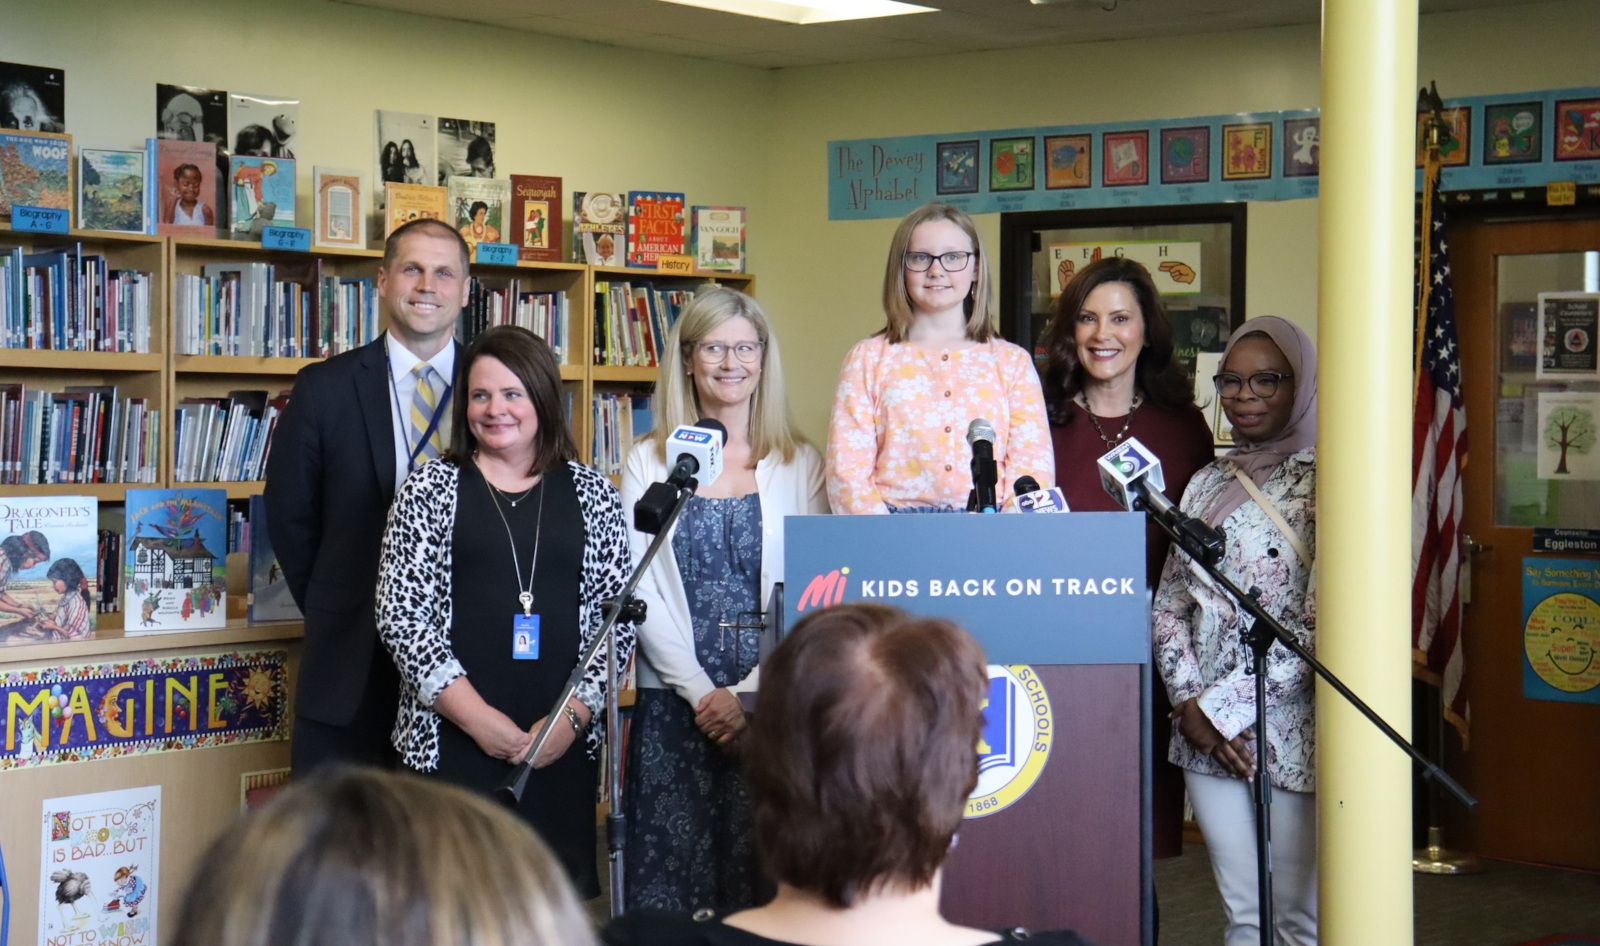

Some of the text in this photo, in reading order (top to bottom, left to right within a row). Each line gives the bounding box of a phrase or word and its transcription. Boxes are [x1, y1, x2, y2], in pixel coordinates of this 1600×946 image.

[32, 145, 68, 160] WOOF
[835, 145, 925, 179] The Dewey
[516, 185, 556, 200] Sequoyah
[846, 177, 919, 211] Alphabet
[20, 208, 62, 222] Biography
[641, 203, 679, 220] FIRST
[578, 223, 625, 236] ATHLETES
[640, 219, 678, 235] FACTS
[700, 225, 739, 234] VAN GOGH
[269, 229, 304, 241] Biography
[637, 244, 679, 254] AMERICAN
[1055, 248, 1062, 260] E
[1083, 248, 1089, 259] F
[1114, 247, 1125, 259] G
[1158, 245, 1168, 257] H
[661, 260, 690, 272] History
[1105, 443, 1131, 461] WNEM
[1118, 448, 1141, 478] 5
[1021, 499, 1034, 507] abc
[1032, 490, 1055, 509] 12
[0, 504, 90, 519] DRAGONFLY'S
[1035, 504, 1058, 513] NEWS
[5, 518, 42, 533] TALE
[1544, 538, 1597, 551] Eggleston
[1526, 566, 1542, 578] Say
[1545, 566, 1592, 581] Something
[862, 578, 1135, 597] KIDS BACK ON TRACK
[1019, 668, 1050, 753] SCHOOLS
[969, 797, 998, 813] 1868
[101, 812, 124, 828] TO
[53, 848, 66, 863] IS
[47, 933, 76, 946] NOT
[79, 929, 97, 943] TO
[98, 932, 145, 946] KNOW
